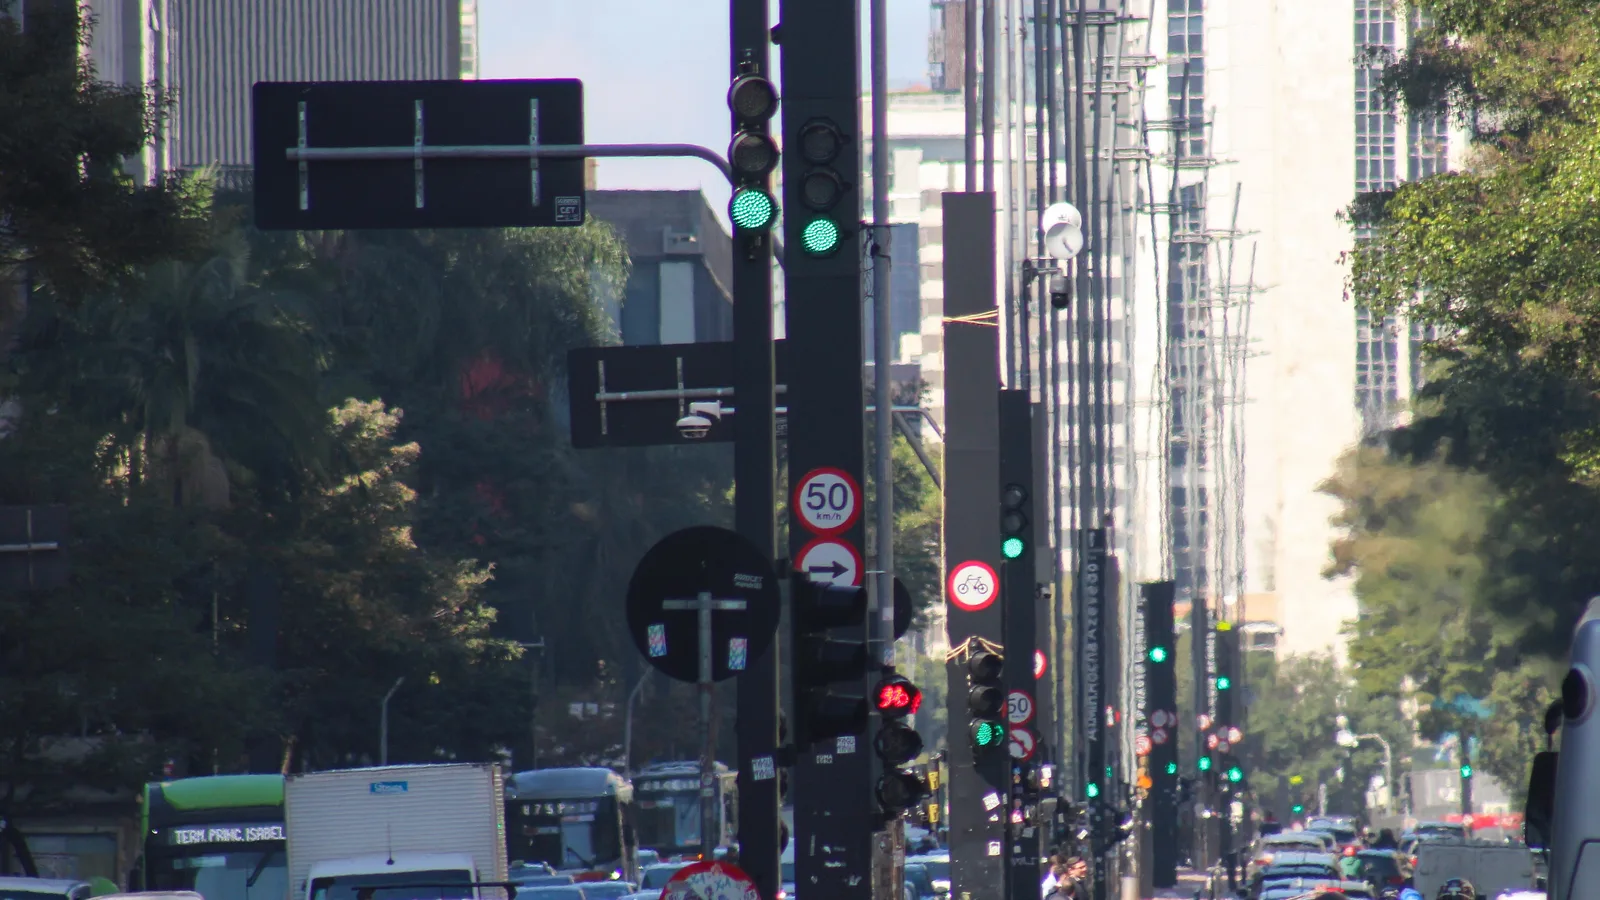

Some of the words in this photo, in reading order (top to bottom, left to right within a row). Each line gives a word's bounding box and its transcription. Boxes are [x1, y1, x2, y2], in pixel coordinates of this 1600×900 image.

[806, 482, 848, 511] 50
[815, 512, 842, 521] km/h
[1008, 697, 1028, 714] 50
[174, 829, 207, 845] TERM.
[246, 825, 287, 841] ISABEL
